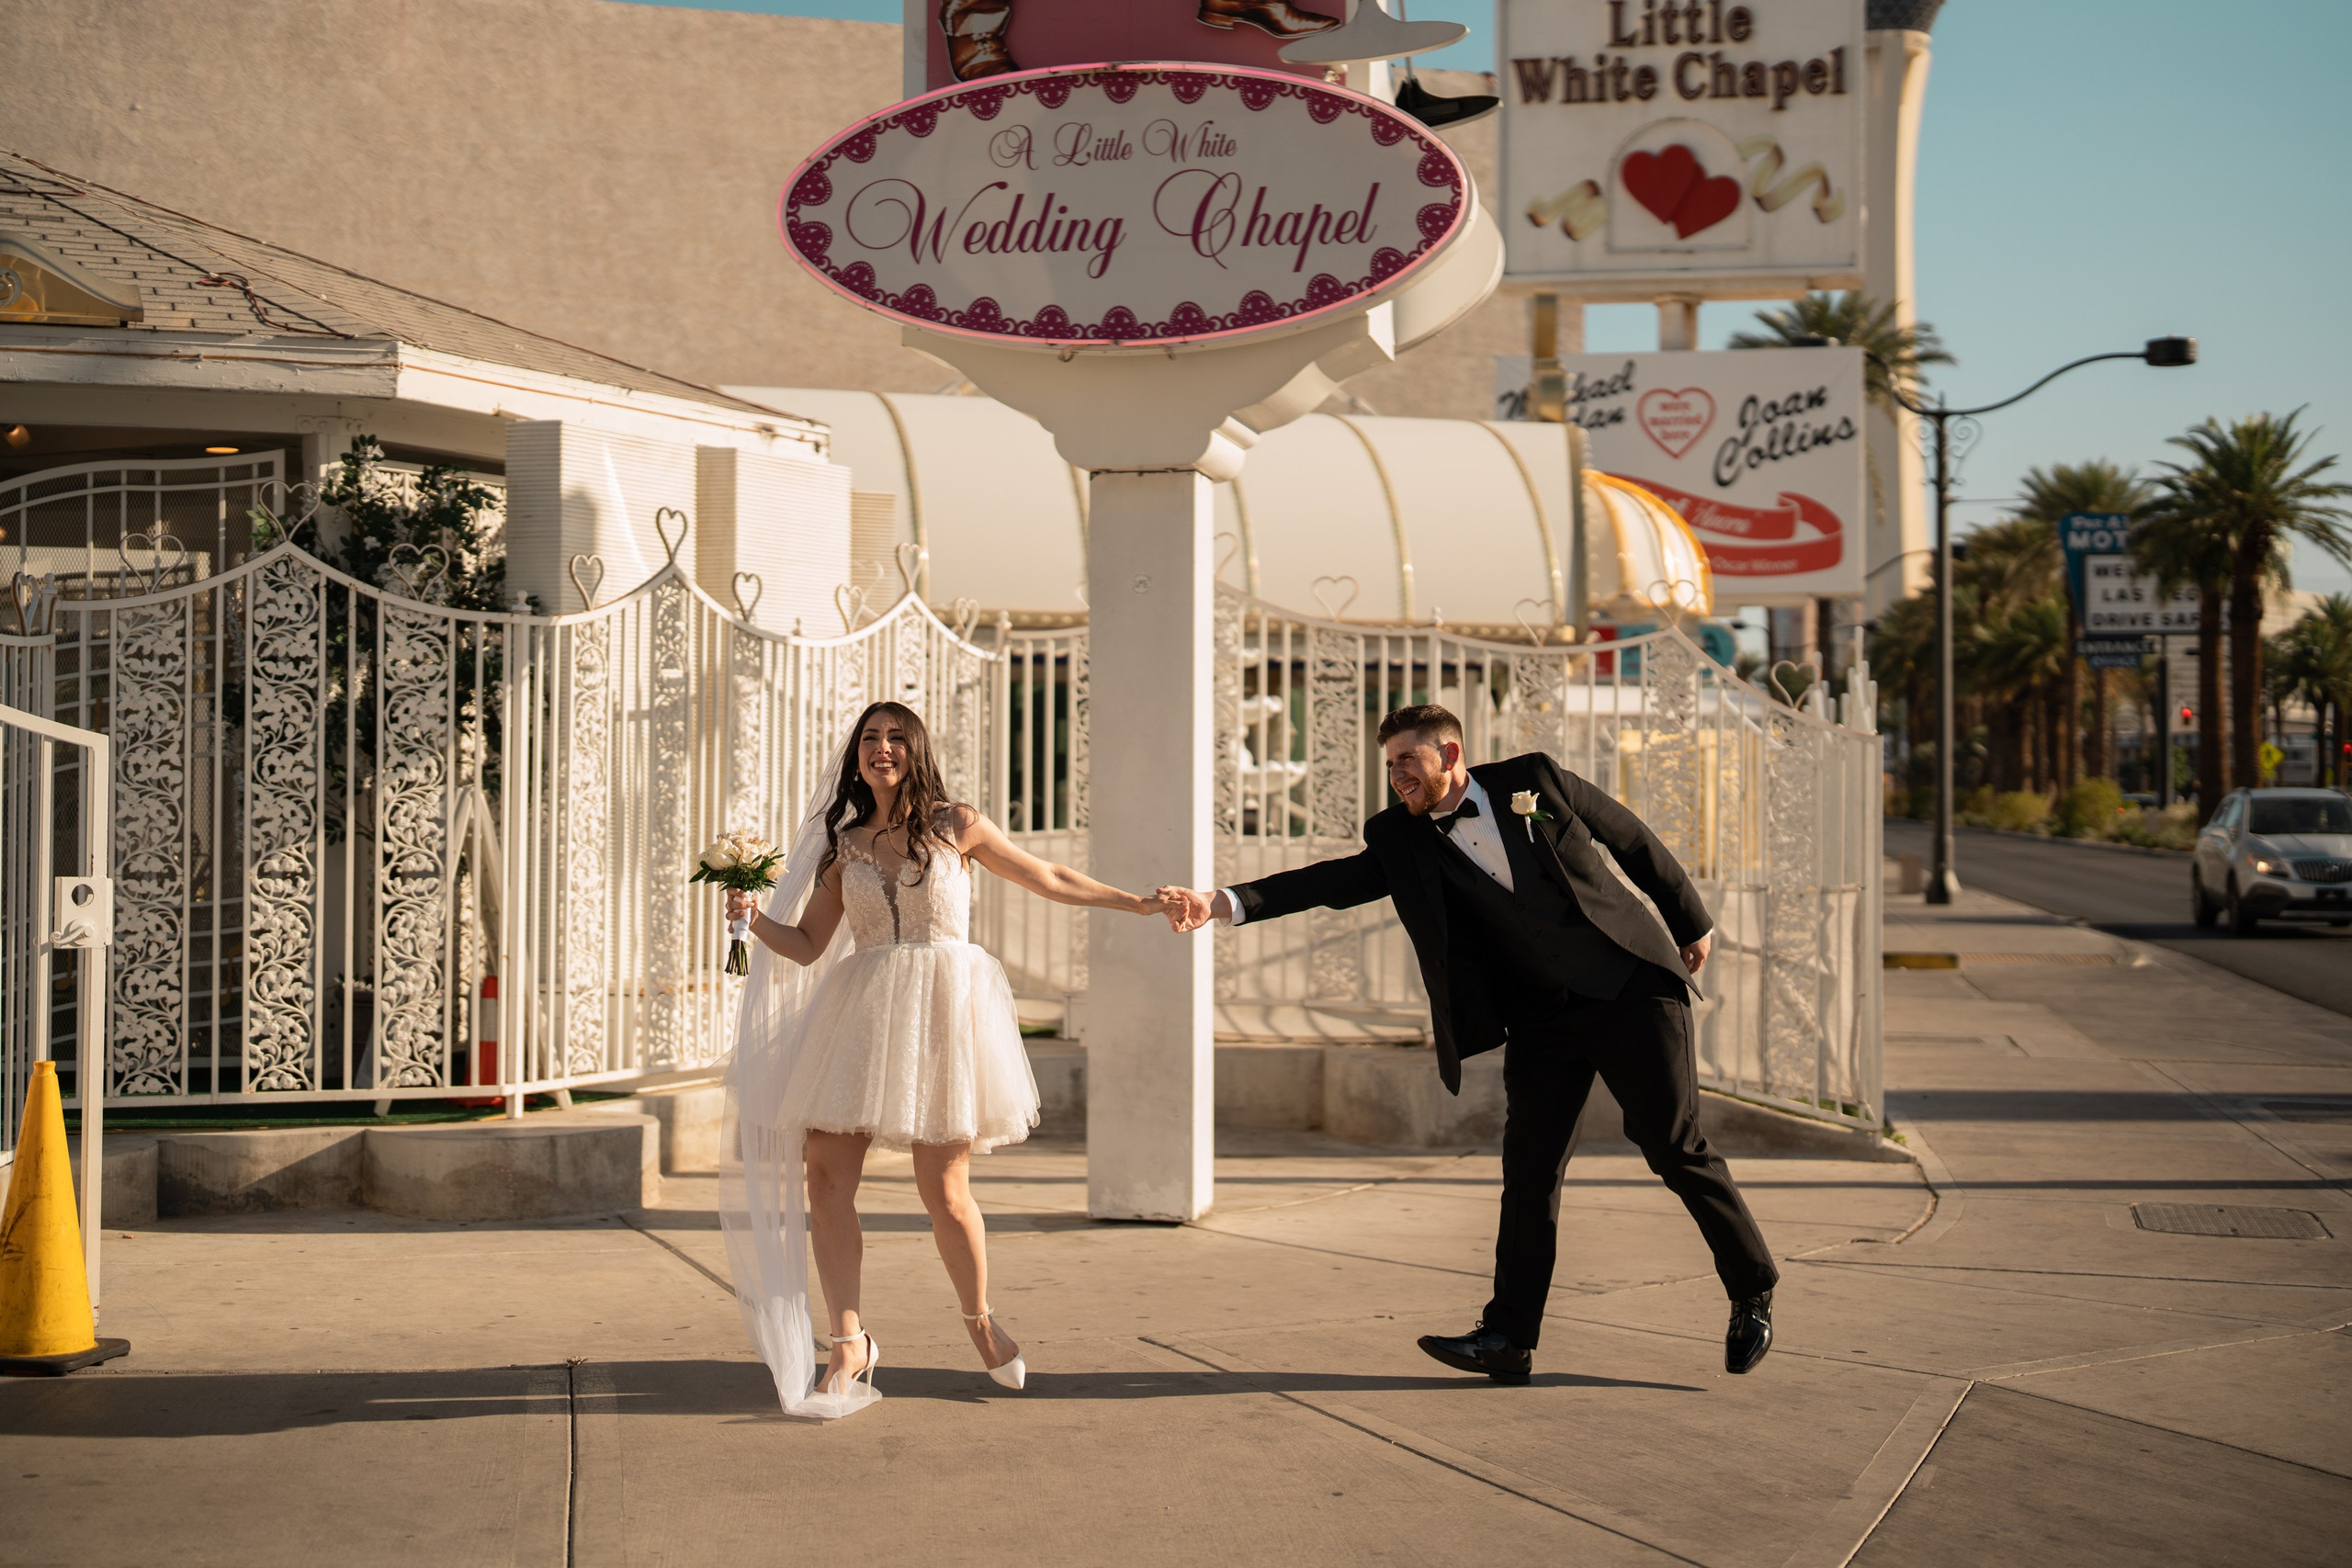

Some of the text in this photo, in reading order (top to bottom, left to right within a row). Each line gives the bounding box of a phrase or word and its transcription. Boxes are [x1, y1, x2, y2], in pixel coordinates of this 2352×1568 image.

[1606, 0, 1755, 48] Little
[1511, 45, 1848, 111] White Chapel
[989, 118, 1238, 171] A Little White
[846, 168, 1381, 279] Wedding Chapel
[1738, 385, 1828, 432] Joan
[1713, 415, 1858, 488] Collins
